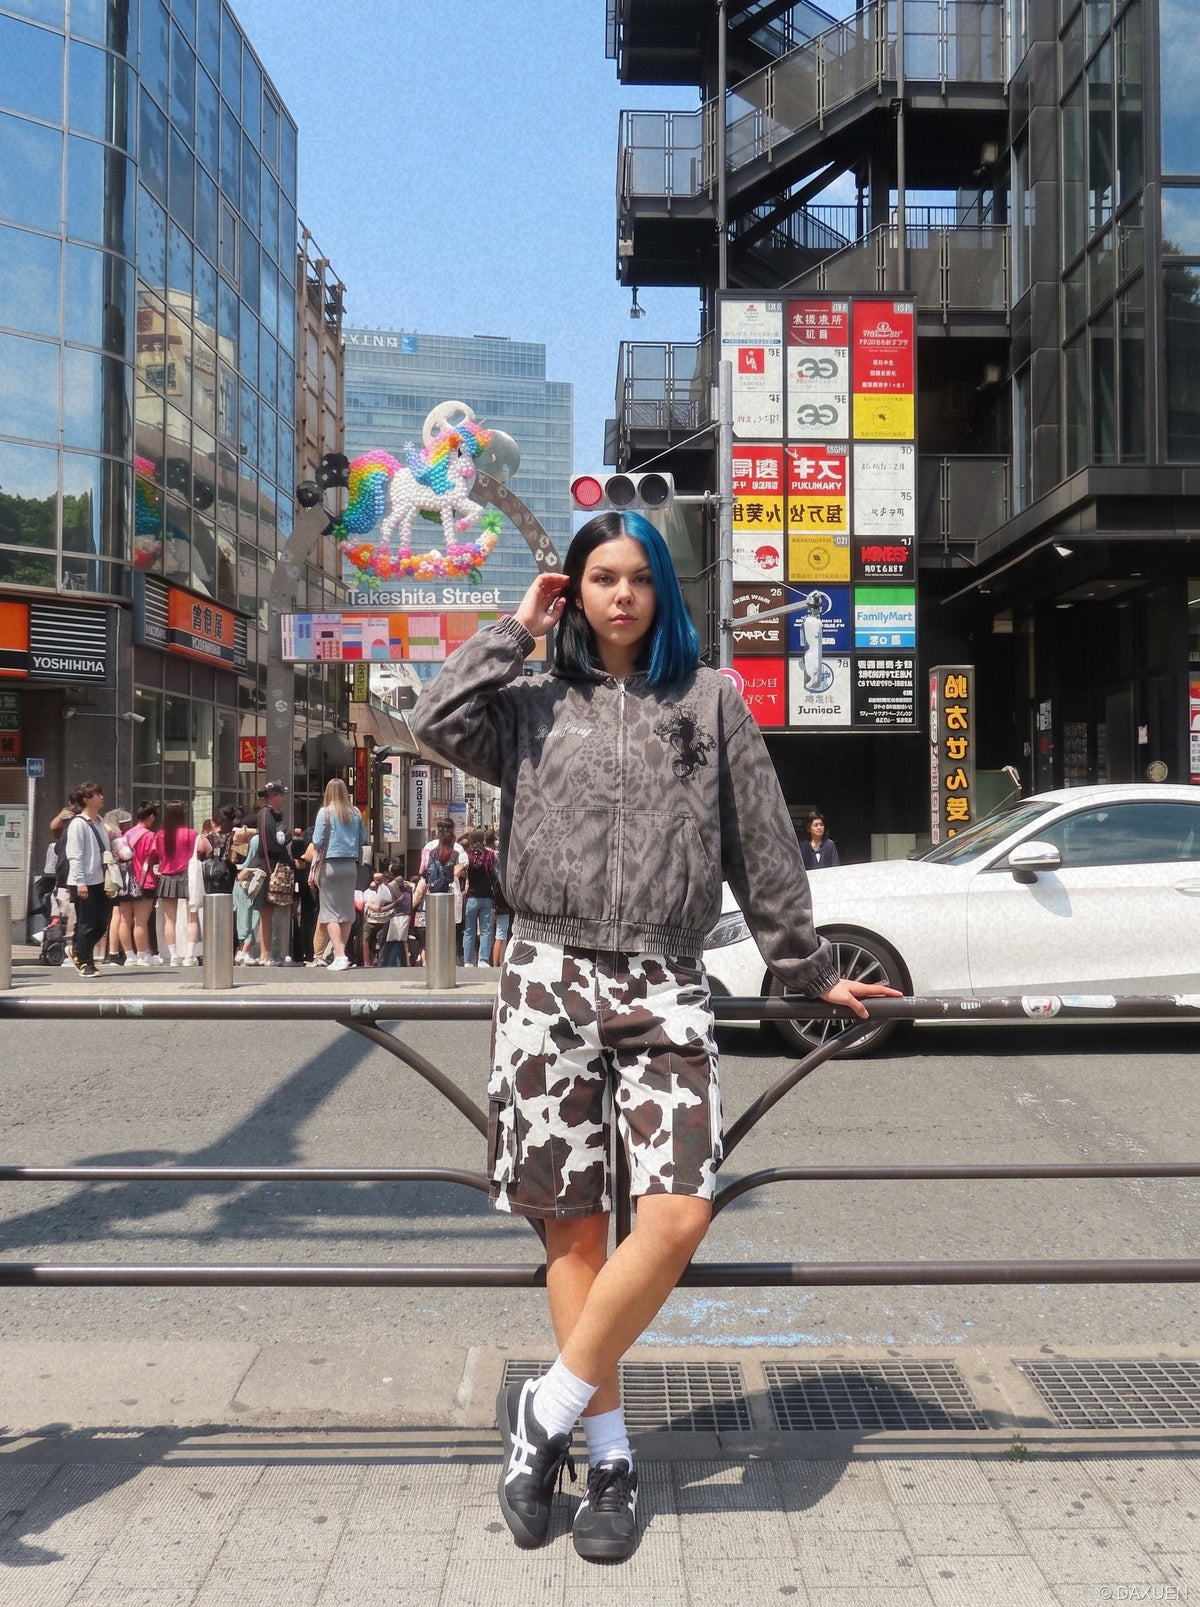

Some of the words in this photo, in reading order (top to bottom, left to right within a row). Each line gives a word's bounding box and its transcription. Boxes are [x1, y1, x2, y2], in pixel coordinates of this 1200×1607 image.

[348, 588, 436, 605] Takeshita
[442, 588, 500, 604] Street
[857, 611, 913, 624] FamilyMart
